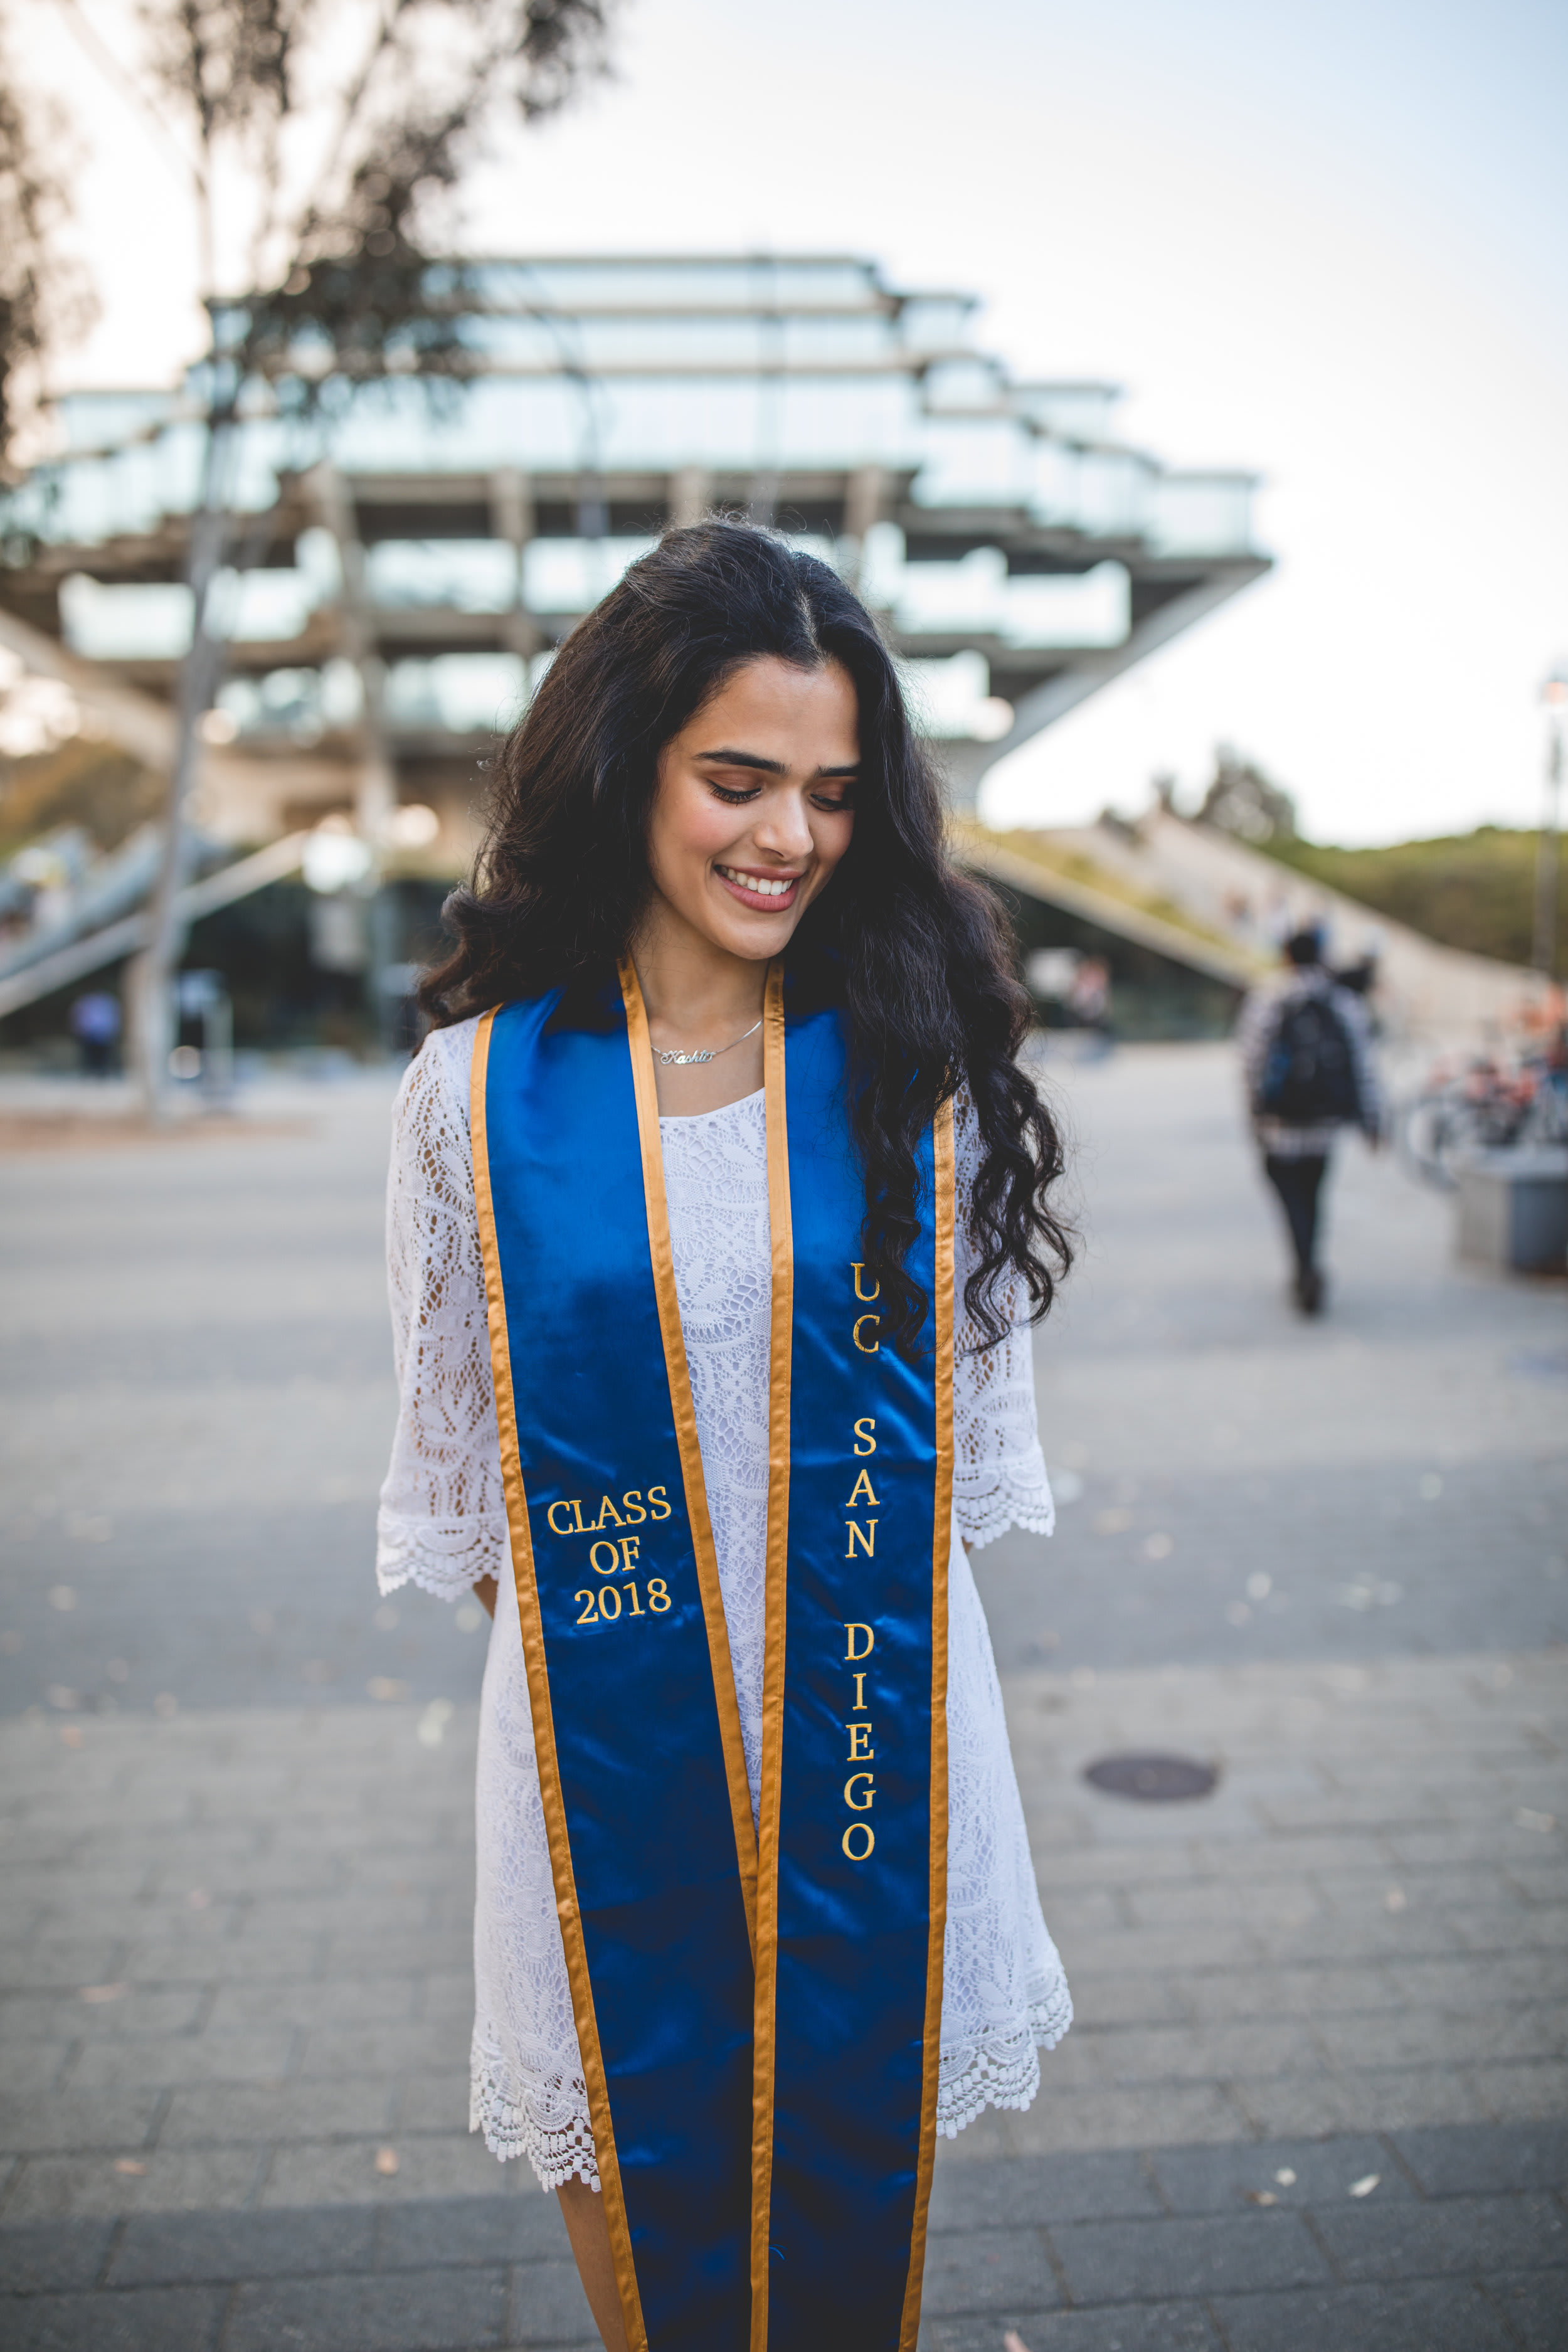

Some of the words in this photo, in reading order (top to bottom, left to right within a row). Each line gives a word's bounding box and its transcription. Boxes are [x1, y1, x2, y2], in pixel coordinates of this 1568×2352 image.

[850, 1262, 881, 1353] UC
[547, 1486, 672, 1535] CLASS
[845, 1417, 881, 1559] SAN
[590, 1536, 640, 1576] OF
[574, 1578, 672, 1624] 2018
[842, 1623, 877, 1862] DIEGO
